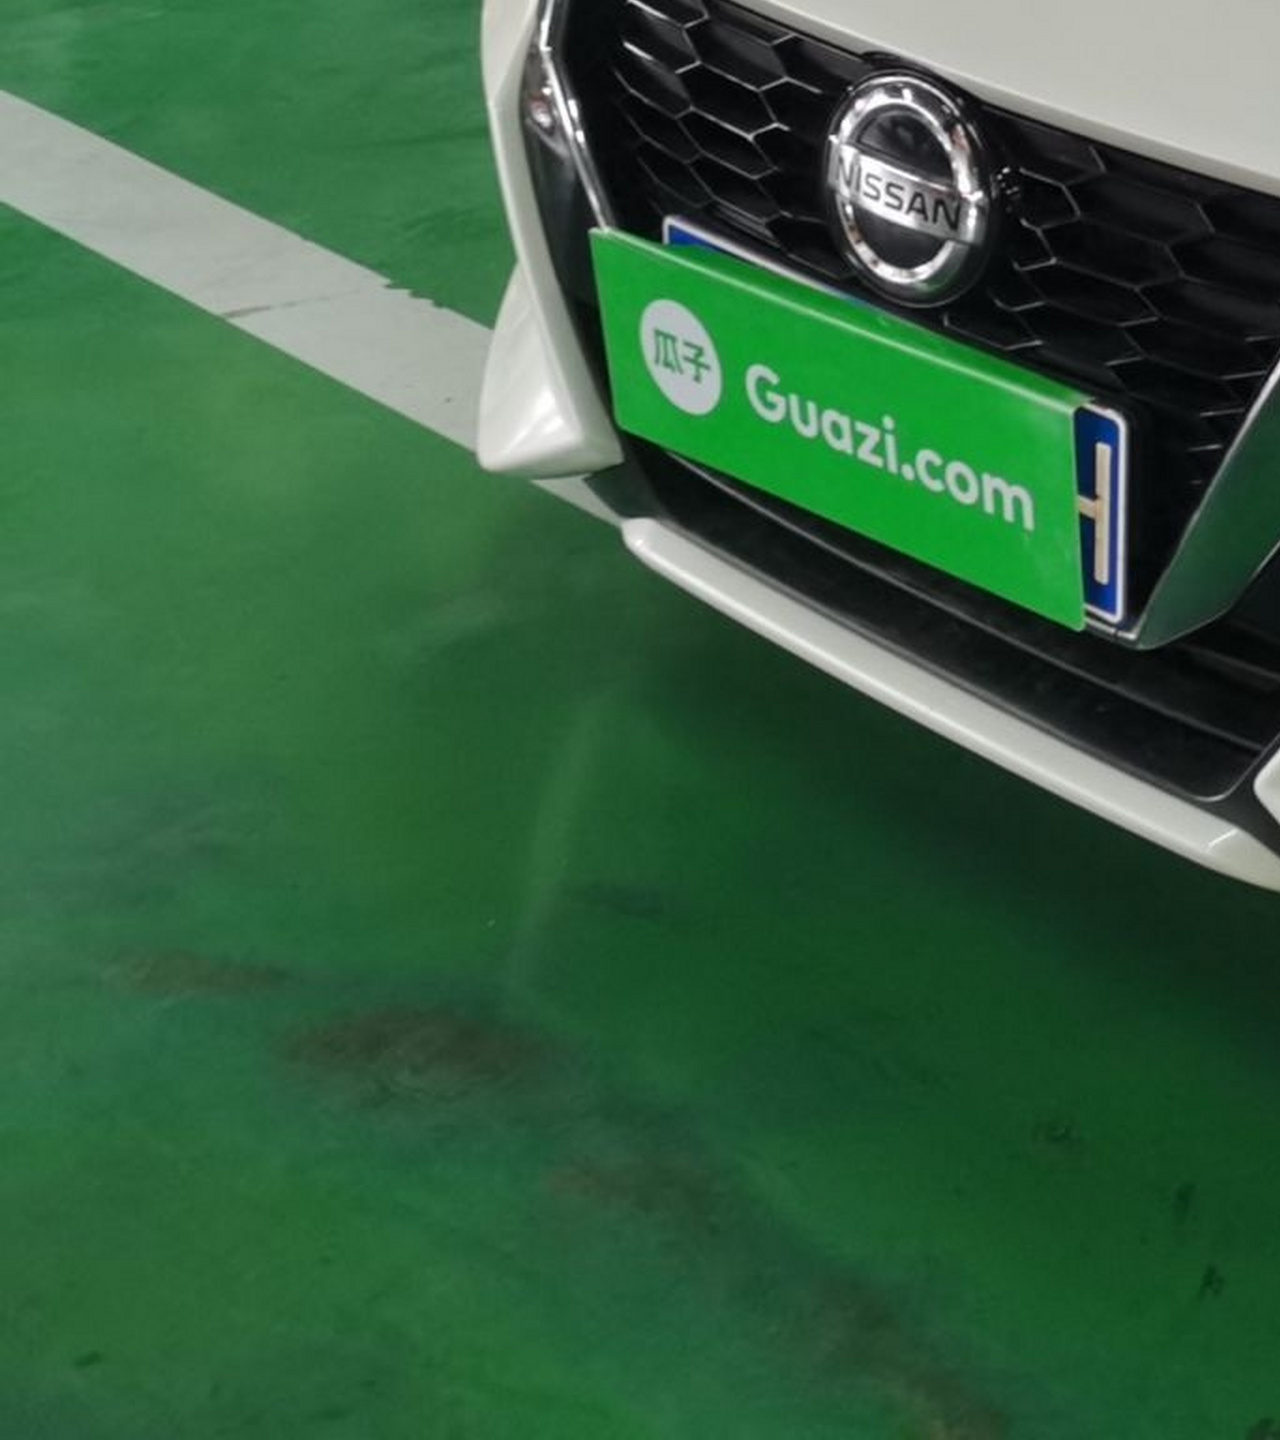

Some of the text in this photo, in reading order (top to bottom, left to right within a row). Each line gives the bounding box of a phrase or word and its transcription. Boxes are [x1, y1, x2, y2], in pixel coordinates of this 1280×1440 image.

[836, 152, 962, 232] NISSAN
[653, 327, 712, 384] 瓜子
[744, 363, 1036, 533] Guazi.com
